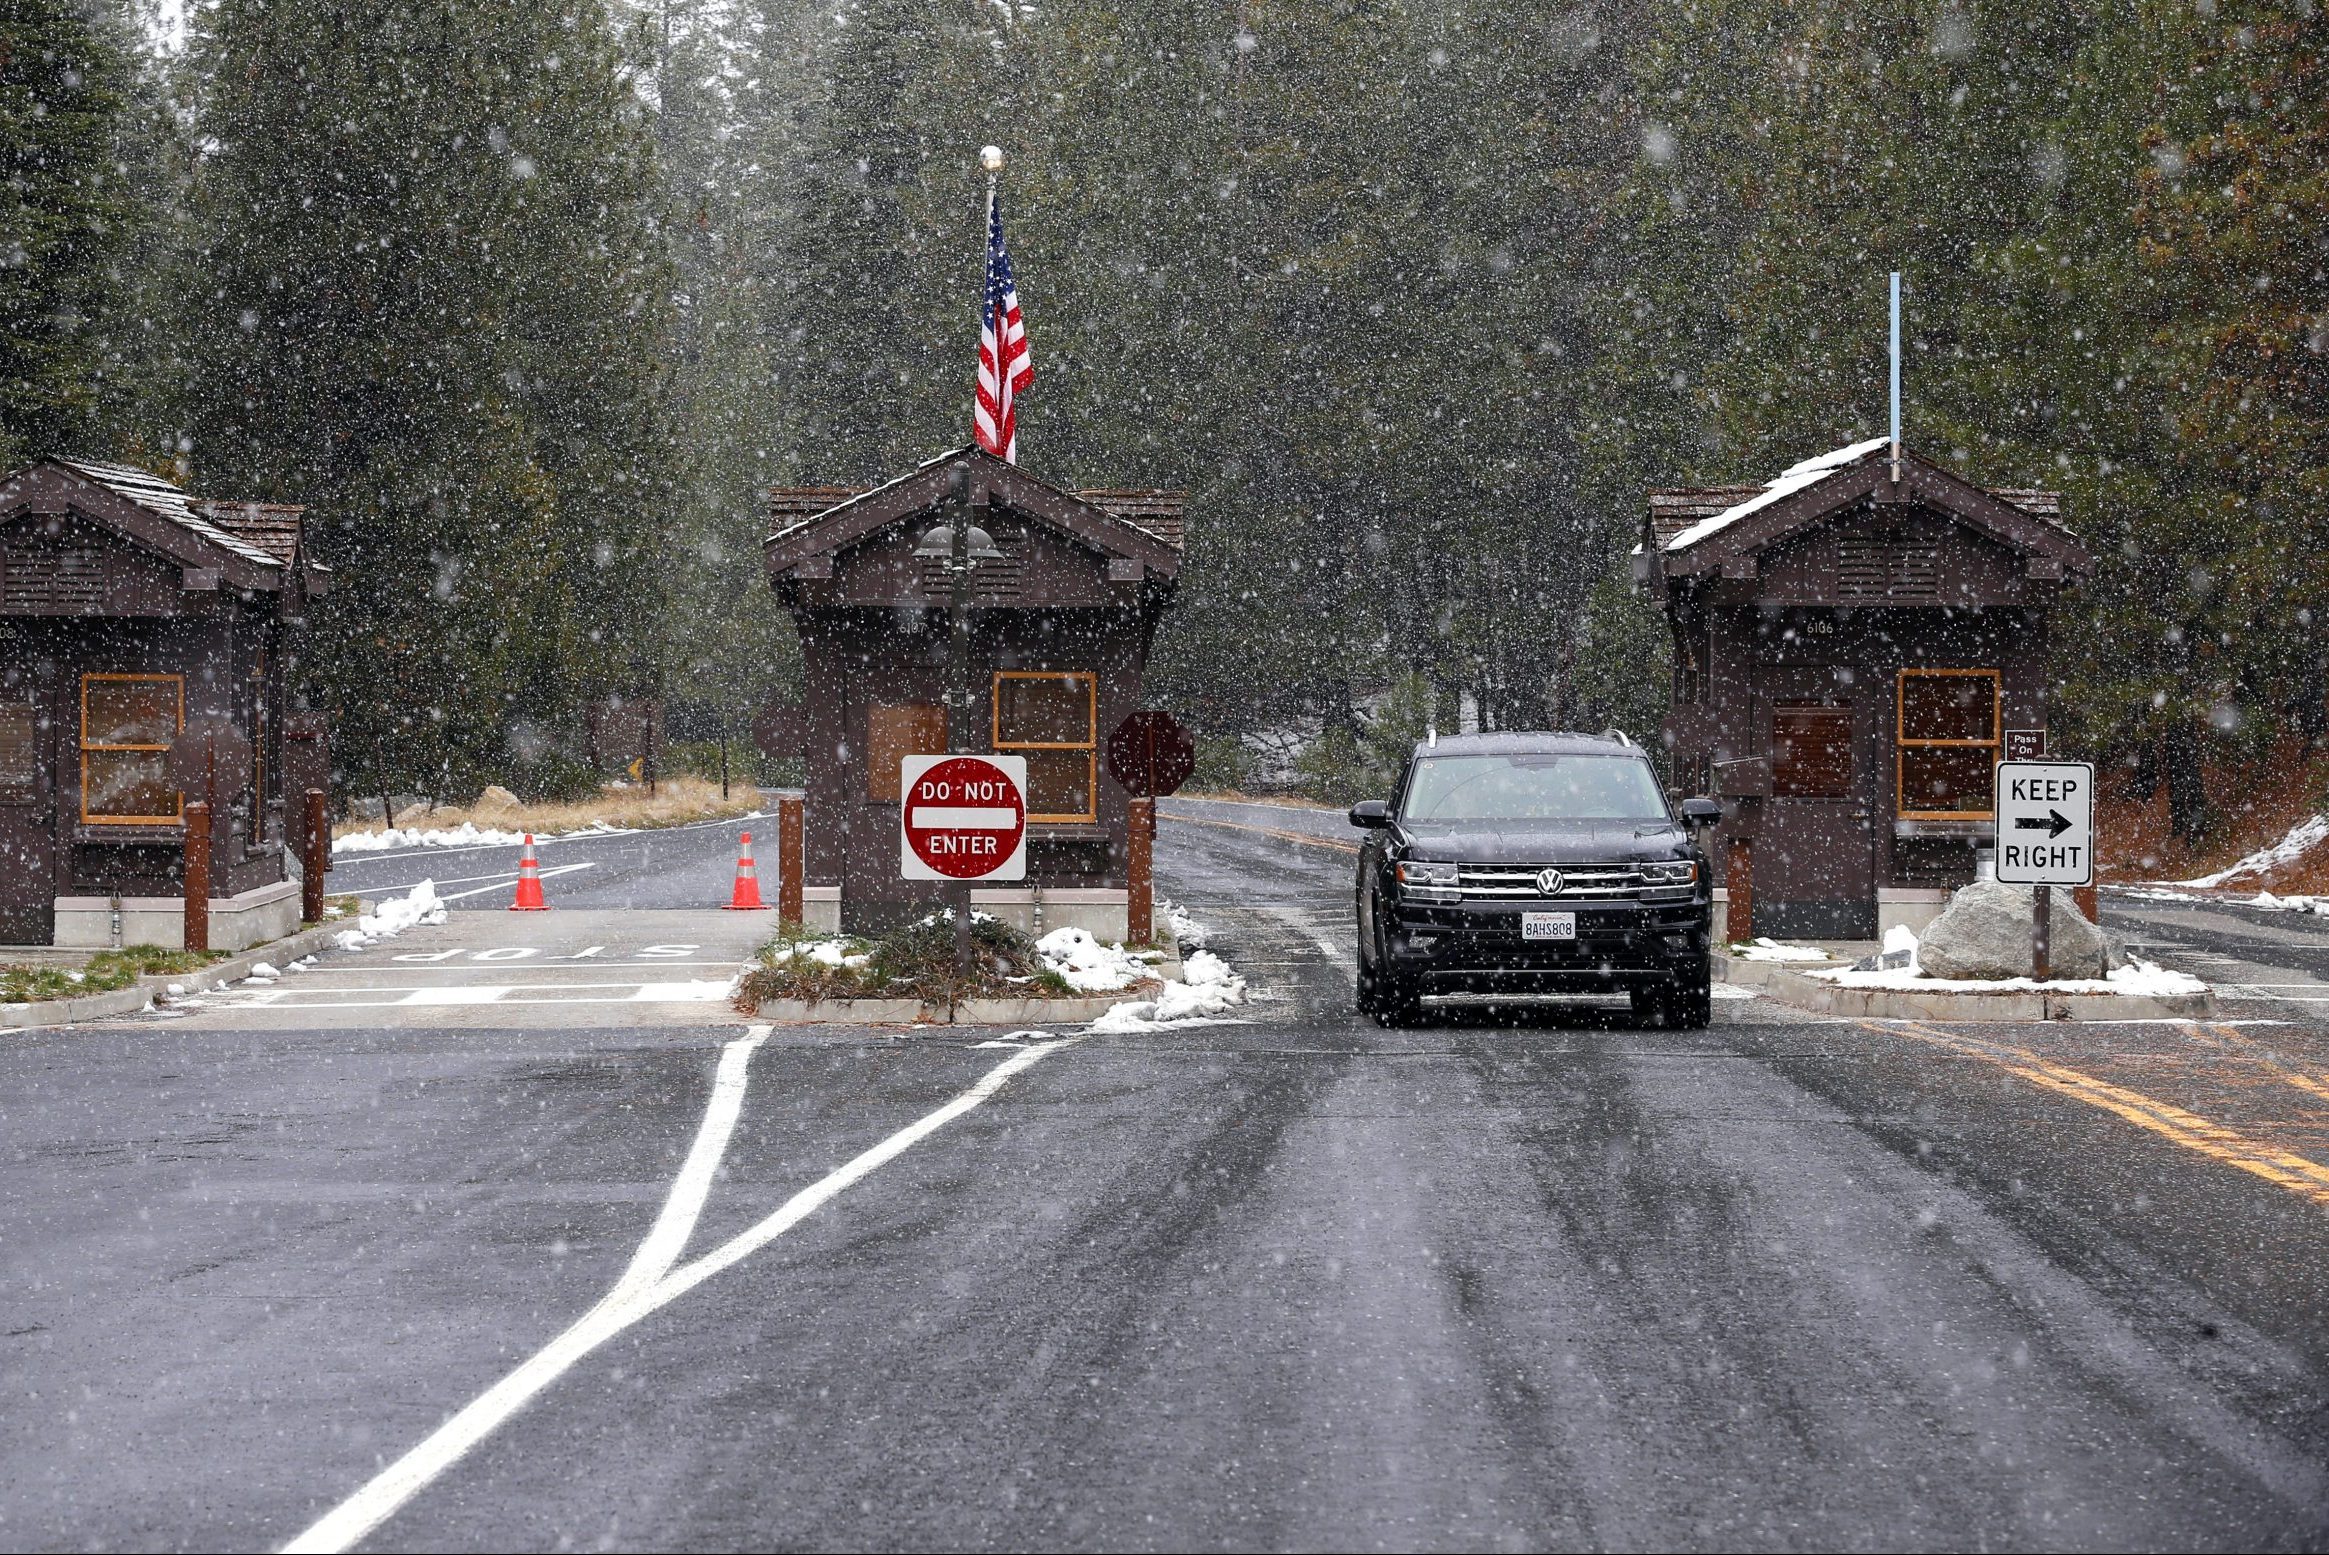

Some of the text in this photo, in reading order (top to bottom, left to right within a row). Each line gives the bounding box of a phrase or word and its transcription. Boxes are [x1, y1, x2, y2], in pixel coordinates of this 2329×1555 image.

[1807, 621, 1834, 634] 6106
[2014, 734, 2037, 744] Pass
[2019, 745, 2033, 755] On
[922, 781, 1007, 801] DO NOT
[2011, 778, 2077, 802] KEEP
[930, 835, 997, 855] ENTER
[2005, 845, 2082, 868] RIGHT
[1525, 922, 1572, 936] 8AHS808
[391, 945, 700, 962] STOP
